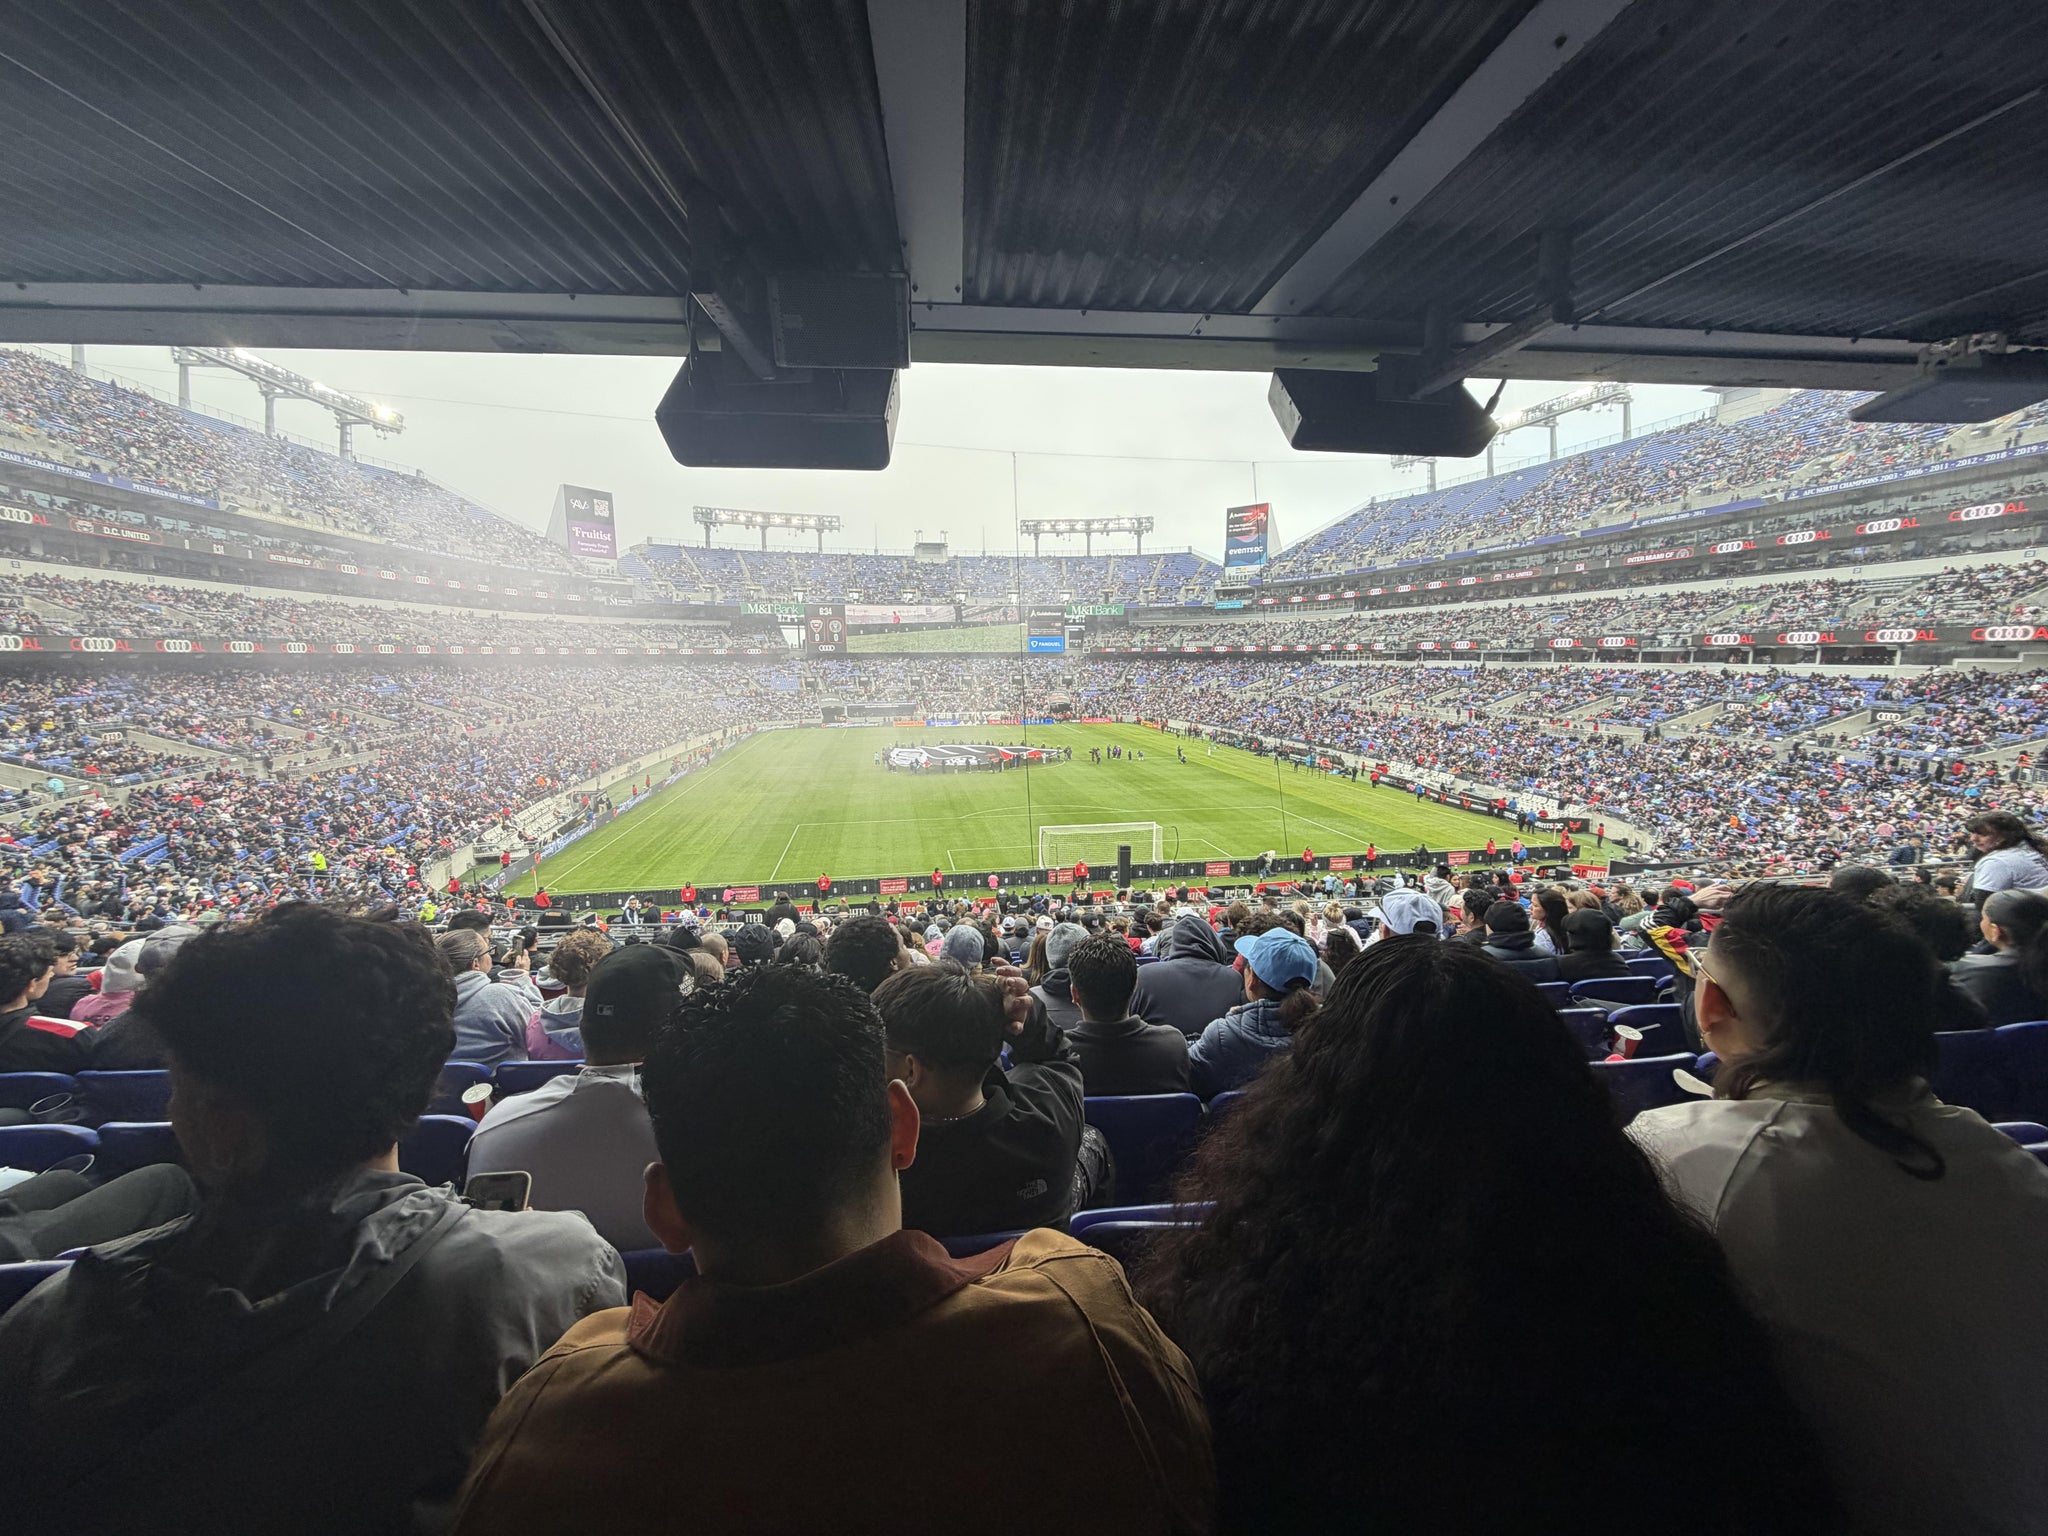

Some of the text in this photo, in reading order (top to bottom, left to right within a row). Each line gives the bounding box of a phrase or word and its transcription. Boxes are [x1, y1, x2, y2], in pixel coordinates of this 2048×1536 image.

[121, 530, 151, 541] UNITED
[748, 603, 799, 614] M&T Bank
[1071, 606, 1118, 615] M&T Bank
